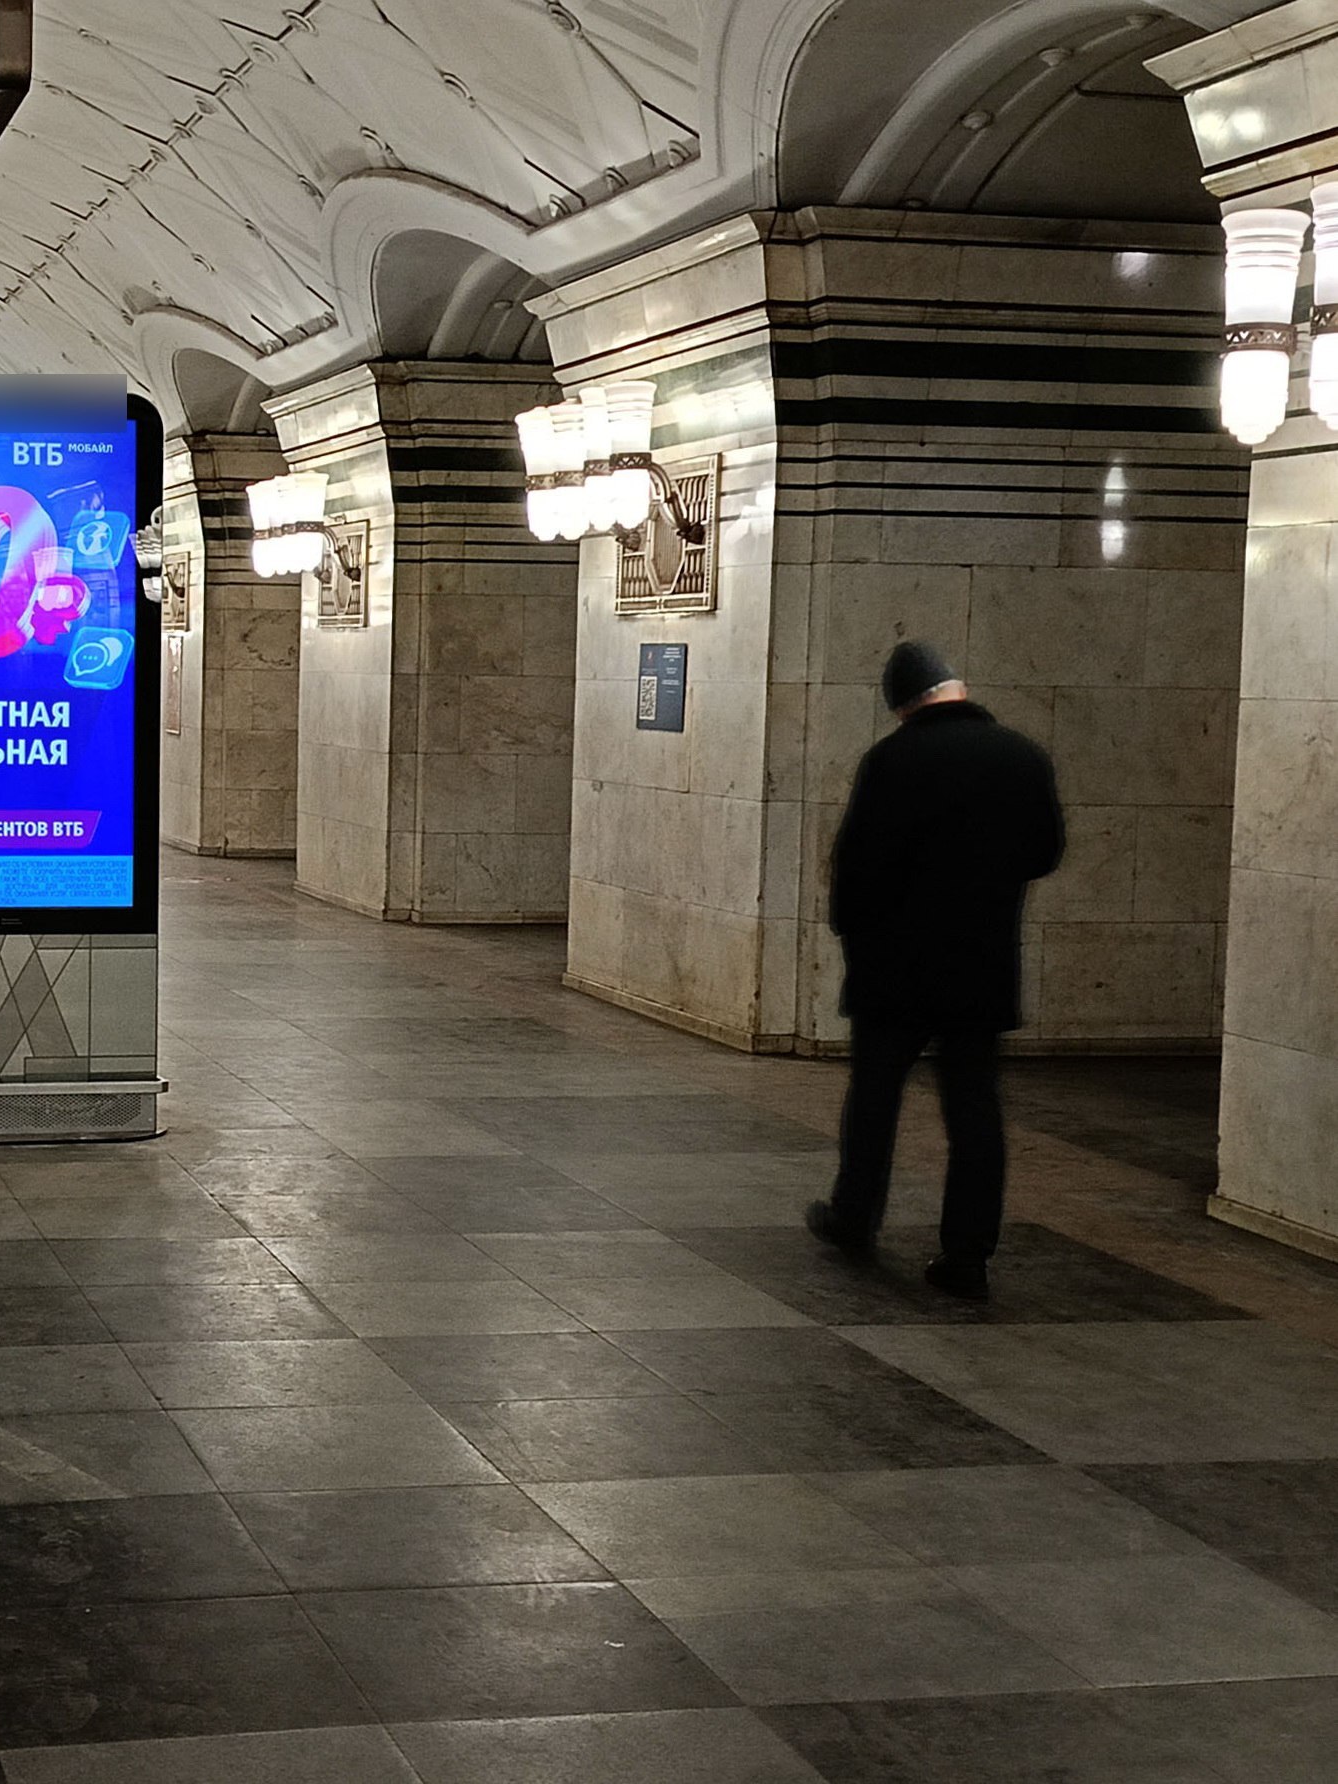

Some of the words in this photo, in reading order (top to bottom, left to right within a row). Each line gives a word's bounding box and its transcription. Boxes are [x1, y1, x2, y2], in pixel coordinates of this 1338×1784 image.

[13, 442, 63, 466] ВТБ
[68, 442, 113, 453] МОБАЙЛ
[53, 820, 85, 838] ВТБ
